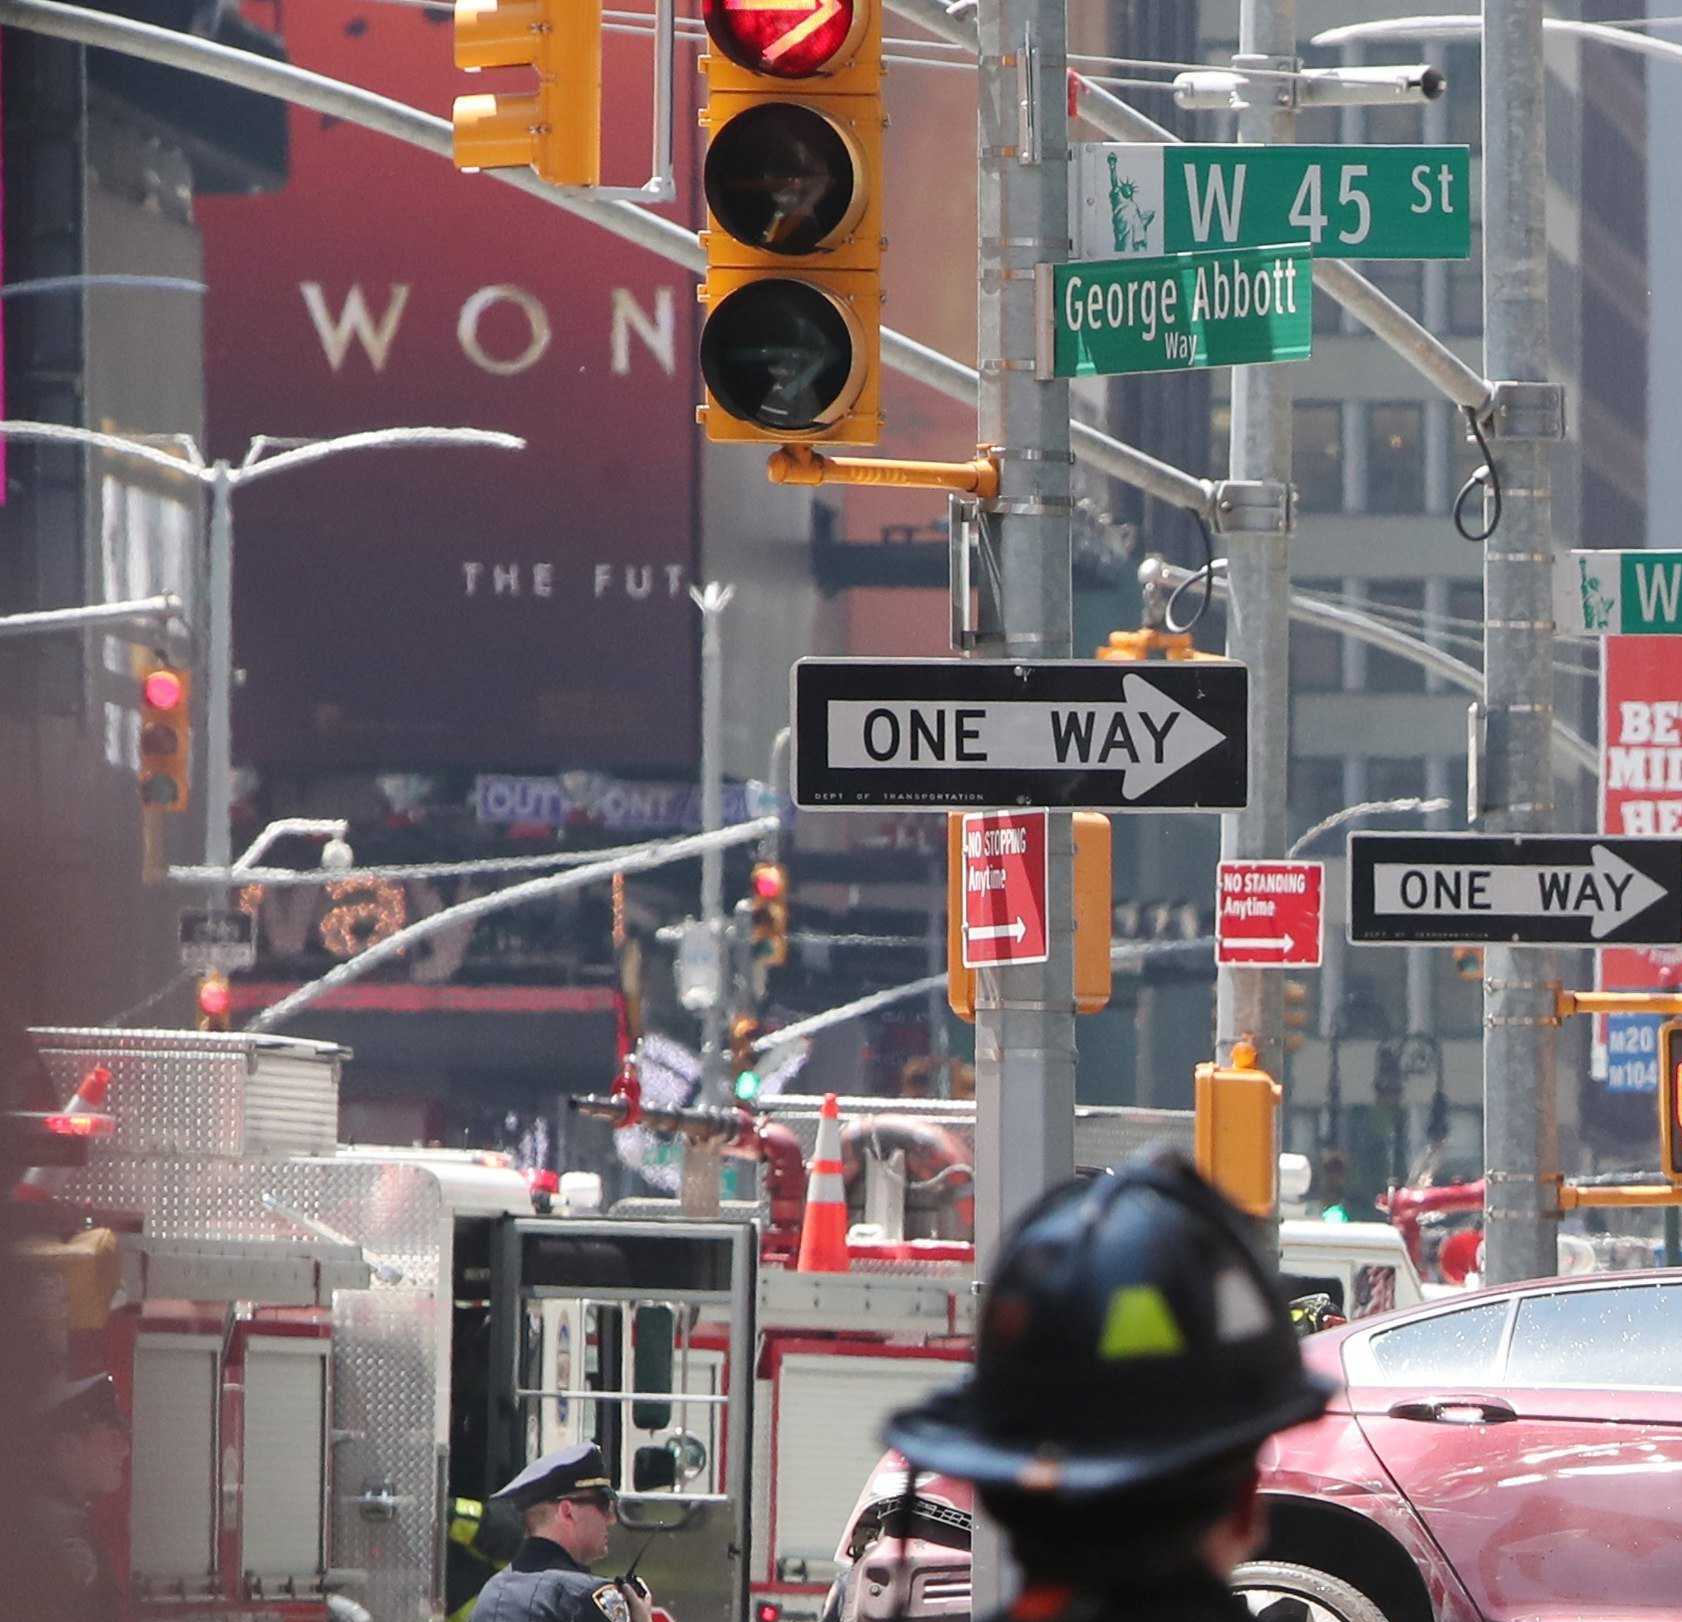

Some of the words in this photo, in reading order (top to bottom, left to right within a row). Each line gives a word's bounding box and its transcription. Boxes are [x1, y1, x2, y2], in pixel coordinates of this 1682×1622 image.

[1184, 164, 1246, 242] W
[1288, 164, 1371, 243] 45
[1409, 163, 1455, 214] St
[1065, 274, 1177, 339] George
[1191, 258, 1297, 322] Abbott
[1164, 331, 1200, 366] Way
[462, 561, 552, 599] THE
[1634, 562, 1682, 623] W
[862, 708, 987, 763] ONE
[1050, 710, 1180, 764] WAY
[814, 792, 844, 800] DEPT
[883, 793, 985, 801] TRANSPORTATION
[968, 830, 982, 858] NO
[983, 826, 1028, 857] STOPPING
[967, 864, 1007, 897] Anytime
[1223, 872, 1241, 893] NO
[1243, 872, 1307, 893] STANDING
[1400, 870, 1492, 911] ONE
[1537, 872, 1635, 912] WAY
[1223, 896, 1276, 921] Anytime
